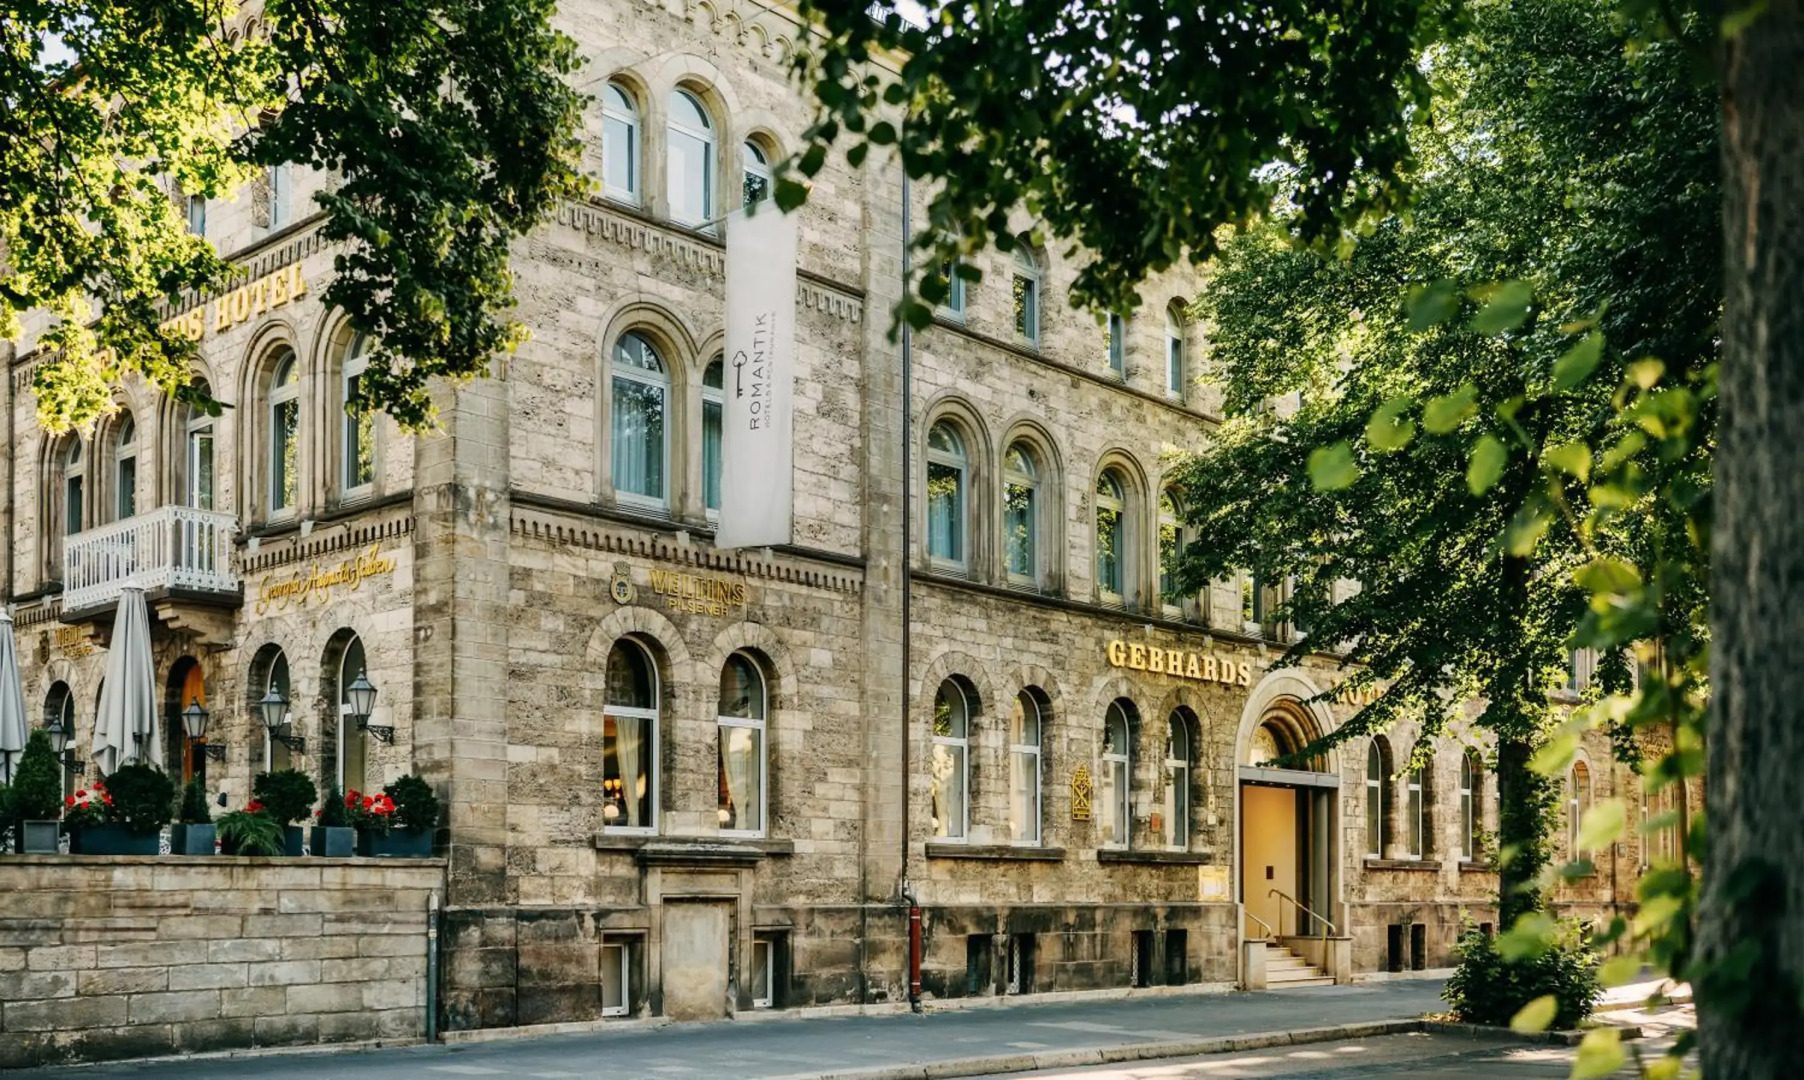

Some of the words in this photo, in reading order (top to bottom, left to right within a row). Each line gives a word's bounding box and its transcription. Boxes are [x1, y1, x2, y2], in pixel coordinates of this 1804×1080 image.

[213, 261, 307, 333] HOTEL
[750, 313, 767, 430] ROMANTIK
[649, 569, 747, 606] VELTINS
[668, 598, 730, 617] PILSENER
[1108, 639, 1251, 687] GEBHARDS
